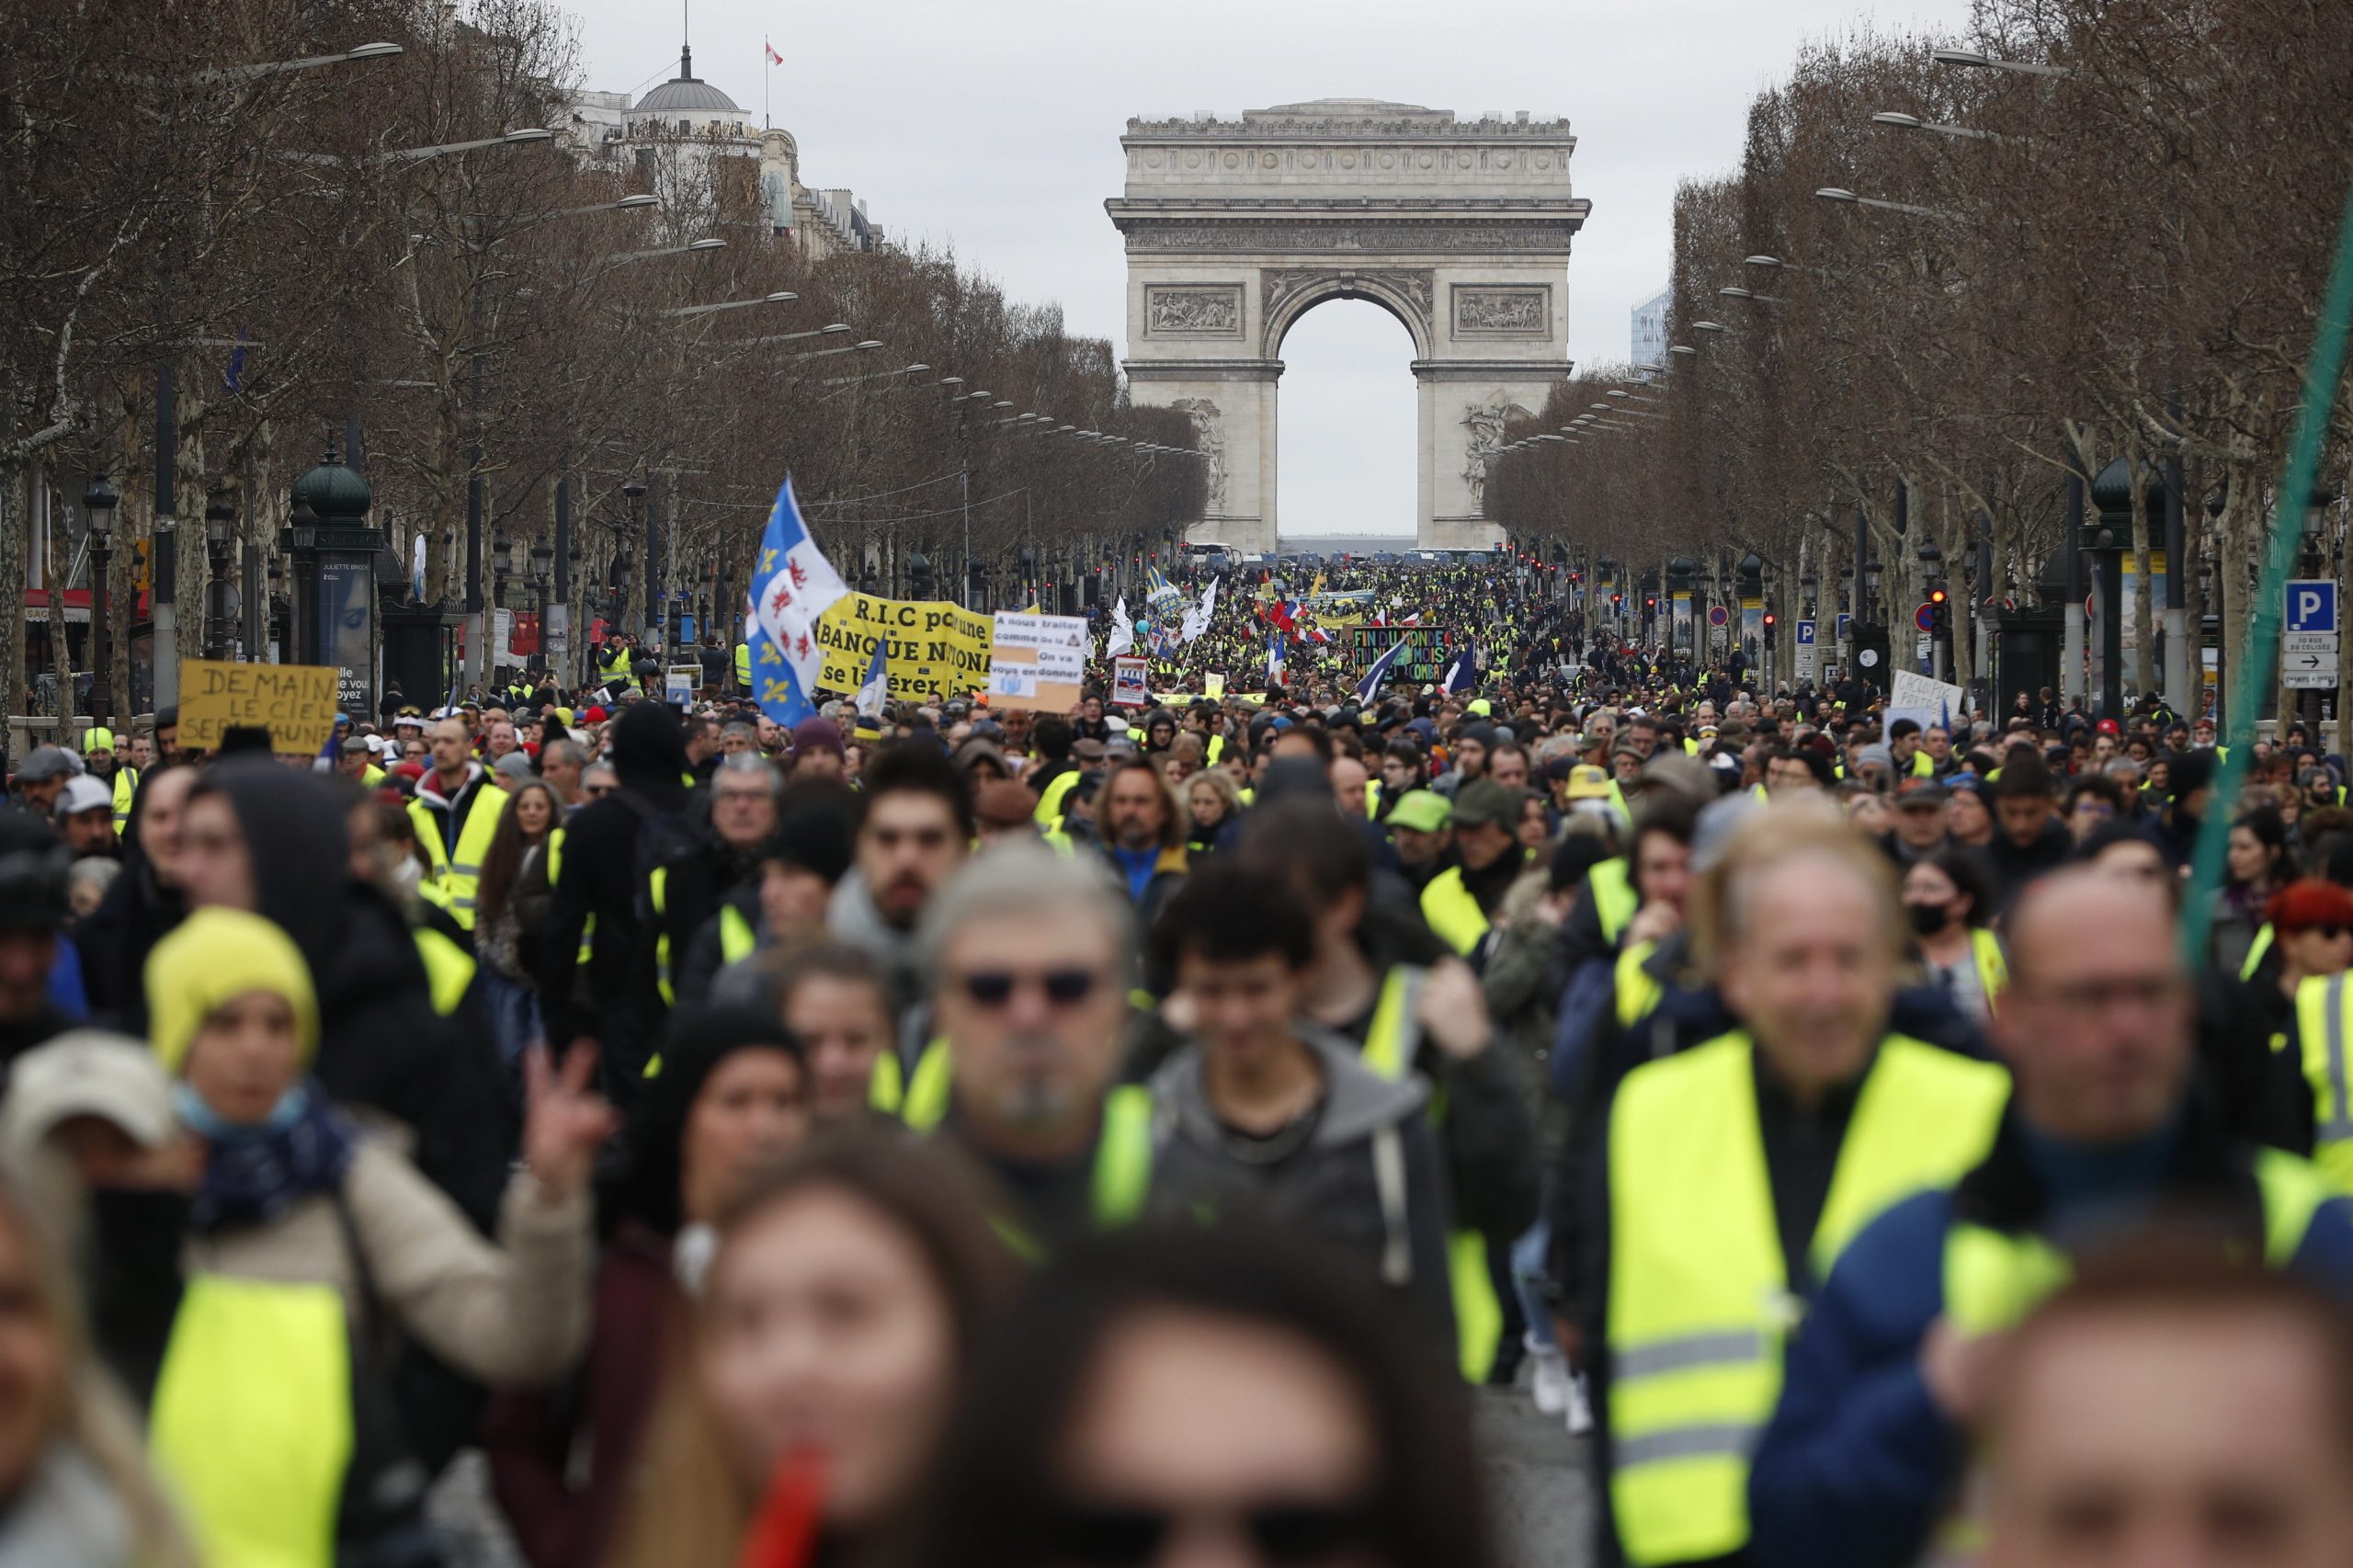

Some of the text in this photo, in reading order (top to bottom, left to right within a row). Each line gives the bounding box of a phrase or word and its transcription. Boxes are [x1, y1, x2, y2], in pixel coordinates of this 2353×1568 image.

[2300, 592, 2321, 623] P
[855, 598, 916, 628] R.I.C
[960, 619, 987, 641] une
[1008, 619, 1037, 628] nous
[1042, 619, 1080, 630] traiter
[995, 632, 1039, 642] comme
[1355, 631, 1376, 646] FIN
[1379, 630, 1398, 646] DU
[1803, 626, 1813, 640] P
[819, 623, 919, 662] BANQUE
[1040, 651, 1074, 663] On va
[1355, 647, 1373, 664] FIN
[1414, 647, 1445, 664] MOIS
[991, 665, 1080, 678] vous en donner
[1409, 664, 1445, 681] COMBAT
[349, 679, 369, 689] vous
[824, 665, 847, 684] se
[851, 666, 940, 696] liérer
[230, 698, 335, 721] LE CIEL
